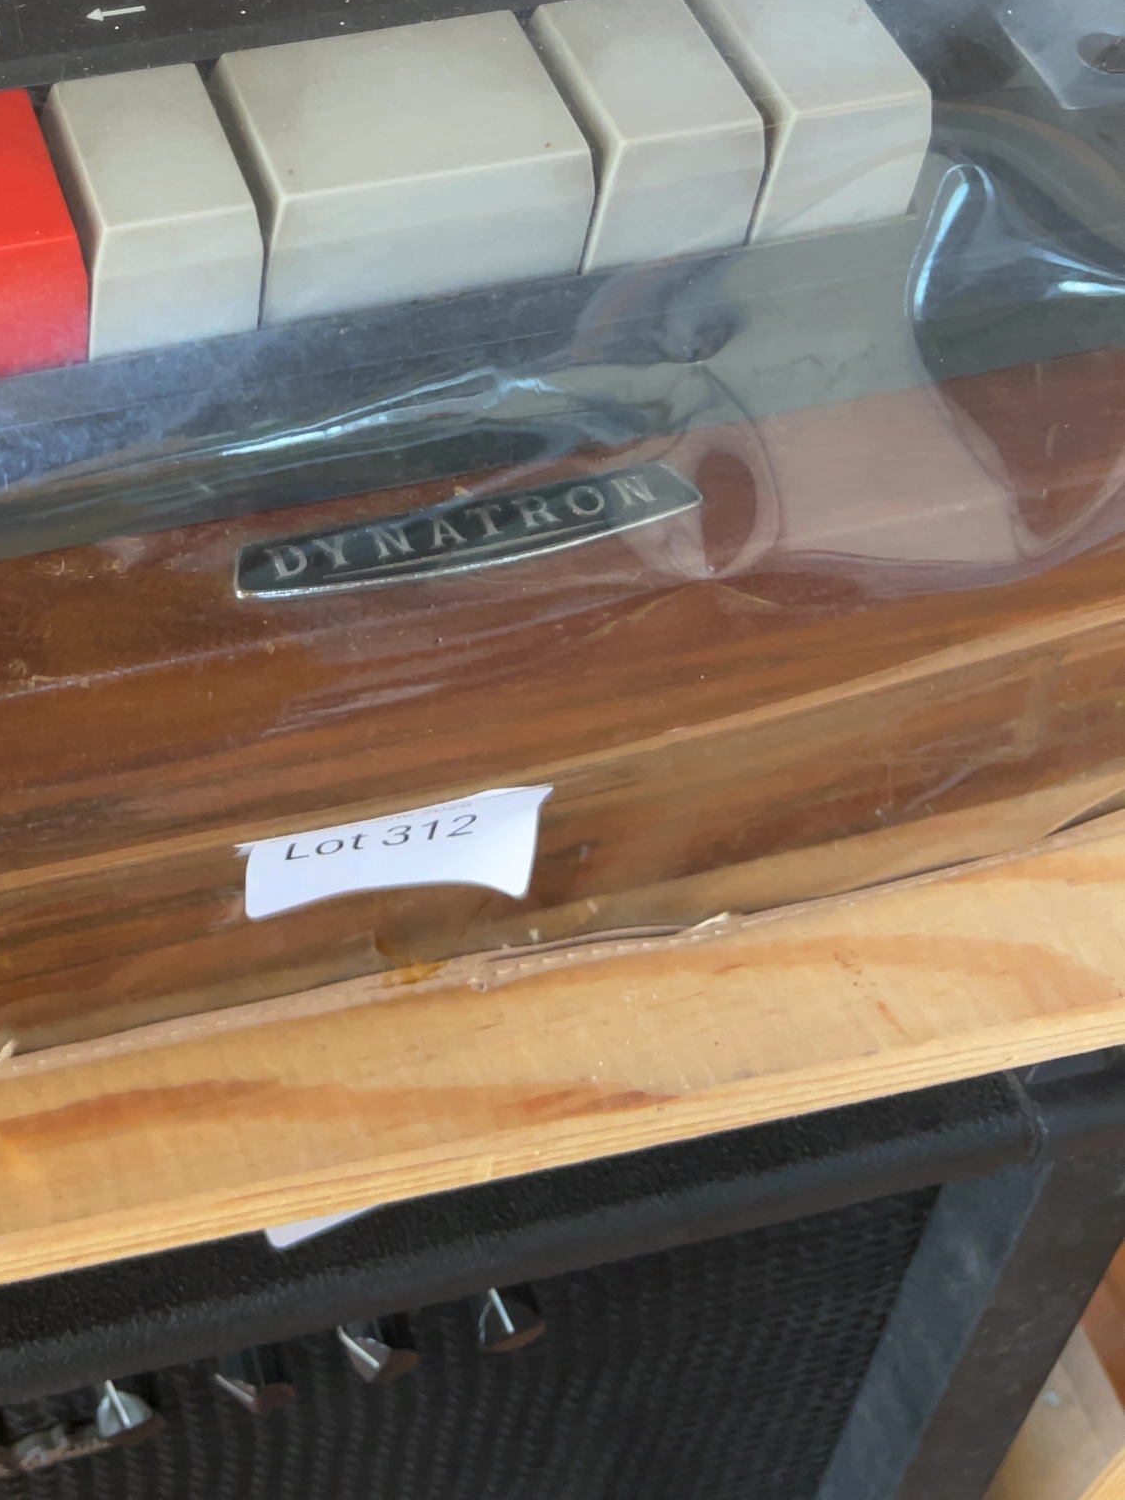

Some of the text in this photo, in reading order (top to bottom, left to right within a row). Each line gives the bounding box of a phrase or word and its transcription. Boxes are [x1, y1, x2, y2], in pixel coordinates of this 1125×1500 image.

[264, 473, 658, 580] DYNATRON
[285, 814, 477, 862] Lot 312
